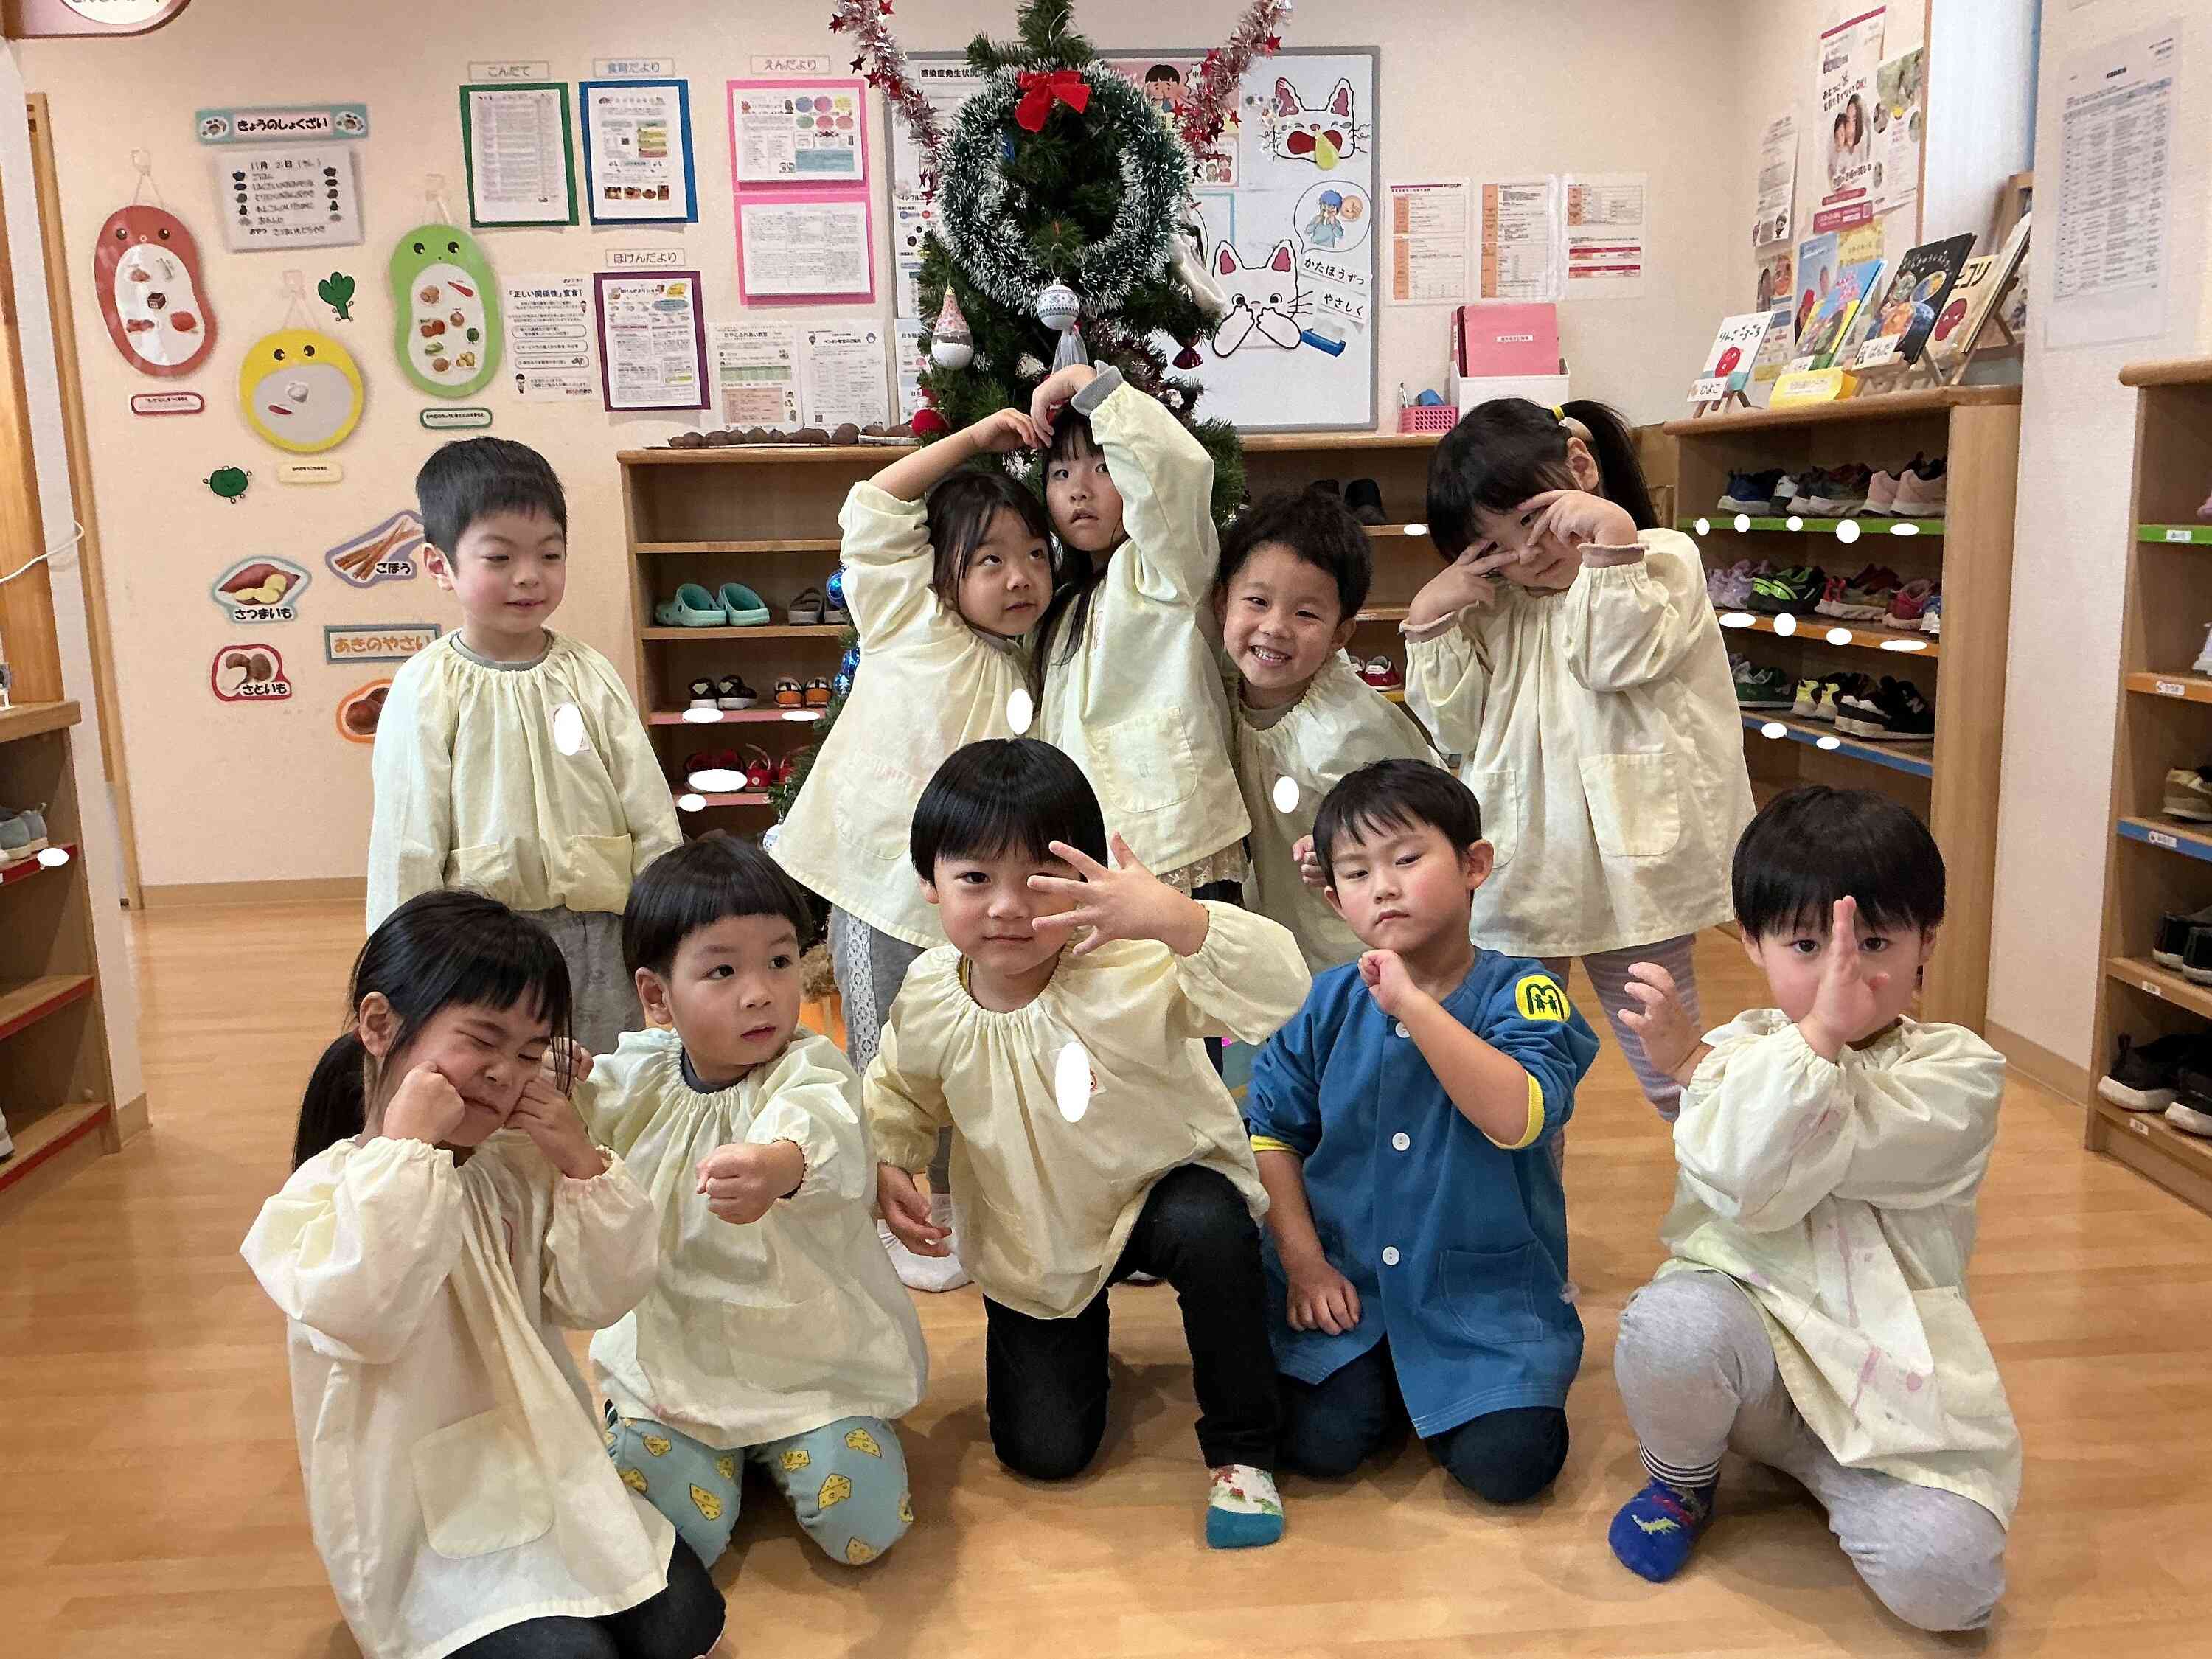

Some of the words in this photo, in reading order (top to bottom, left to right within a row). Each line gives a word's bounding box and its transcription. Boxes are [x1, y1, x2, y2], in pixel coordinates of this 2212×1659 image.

[487, 66, 532, 77] こんだて
[765, 60, 817, 71] えんだより
[237, 116, 328, 131] きょうのしょくざい
[613, 251, 678, 264] ほけんだより
[1324, 293, 1363, 316] やさしく
[234, 608, 292, 620] さつまいも
[334, 635, 431, 653] あきのやさい
[242, 683, 288, 695] さといも
